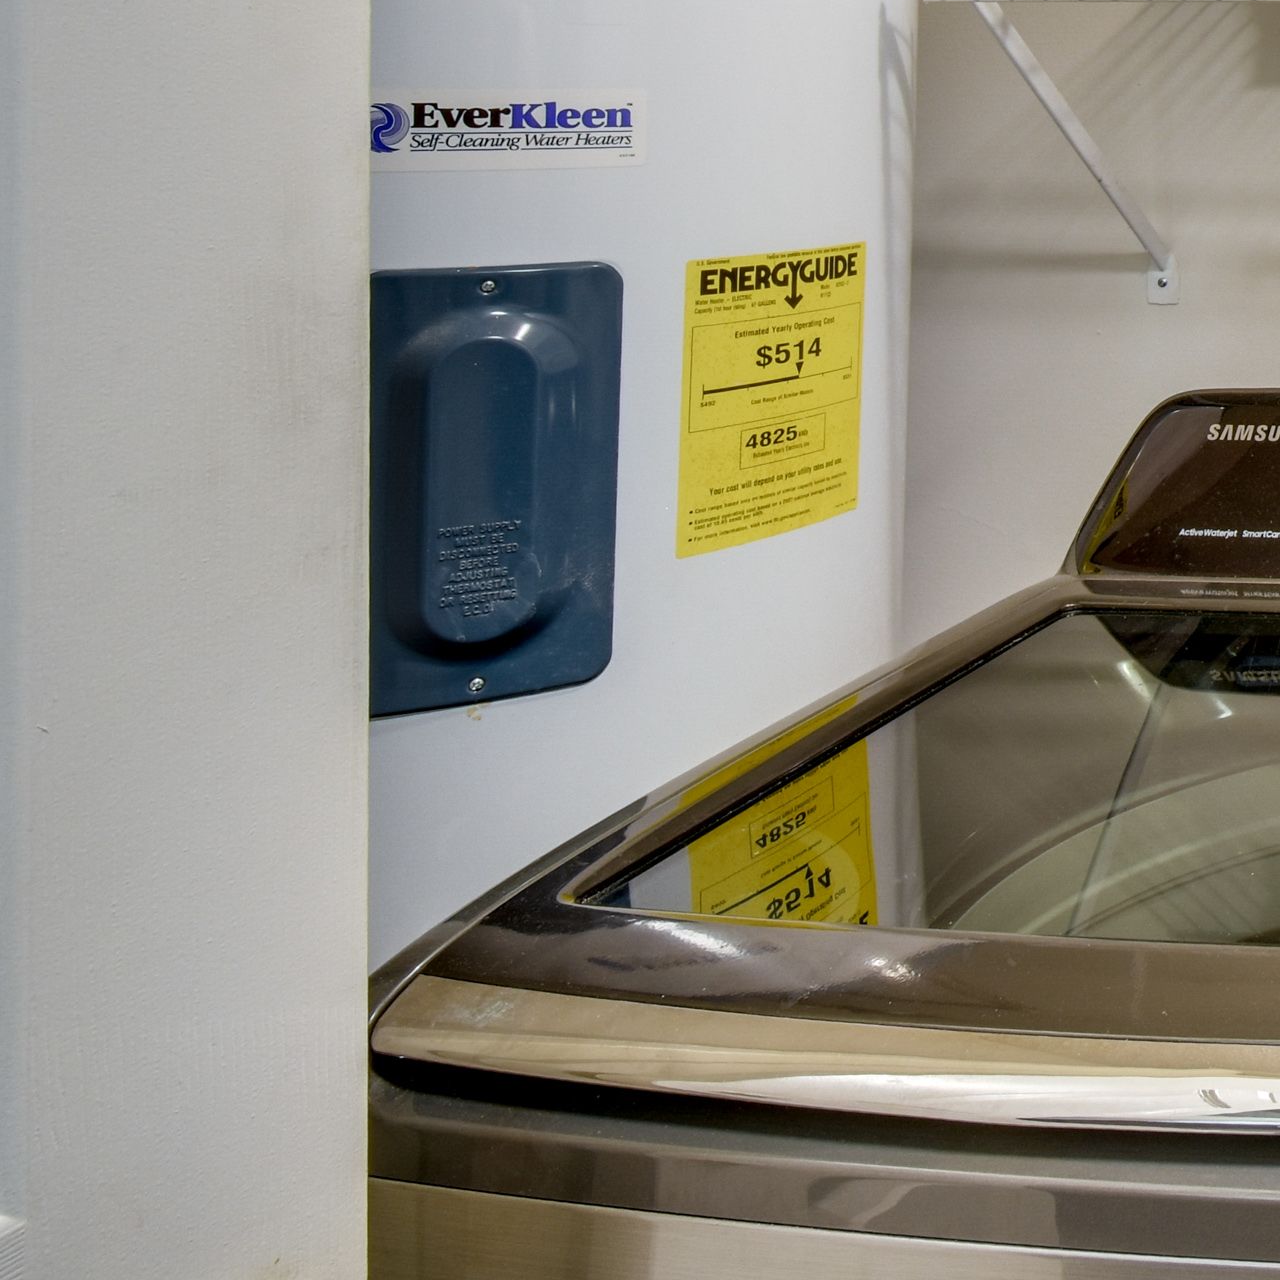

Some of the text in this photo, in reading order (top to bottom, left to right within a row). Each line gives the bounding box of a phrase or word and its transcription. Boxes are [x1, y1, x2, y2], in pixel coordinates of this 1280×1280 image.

[410, 102, 633, 129] EverKleen
[409, 133, 633, 150] Self-Cleaning Water Heaters
[700, 252, 858, 296] ENERGYGUIDE
[734, 317, 836, 339] Estimated Yearly Operating Cost
[755, 337, 823, 369] $514
[745, 425, 799, 449] 4825
